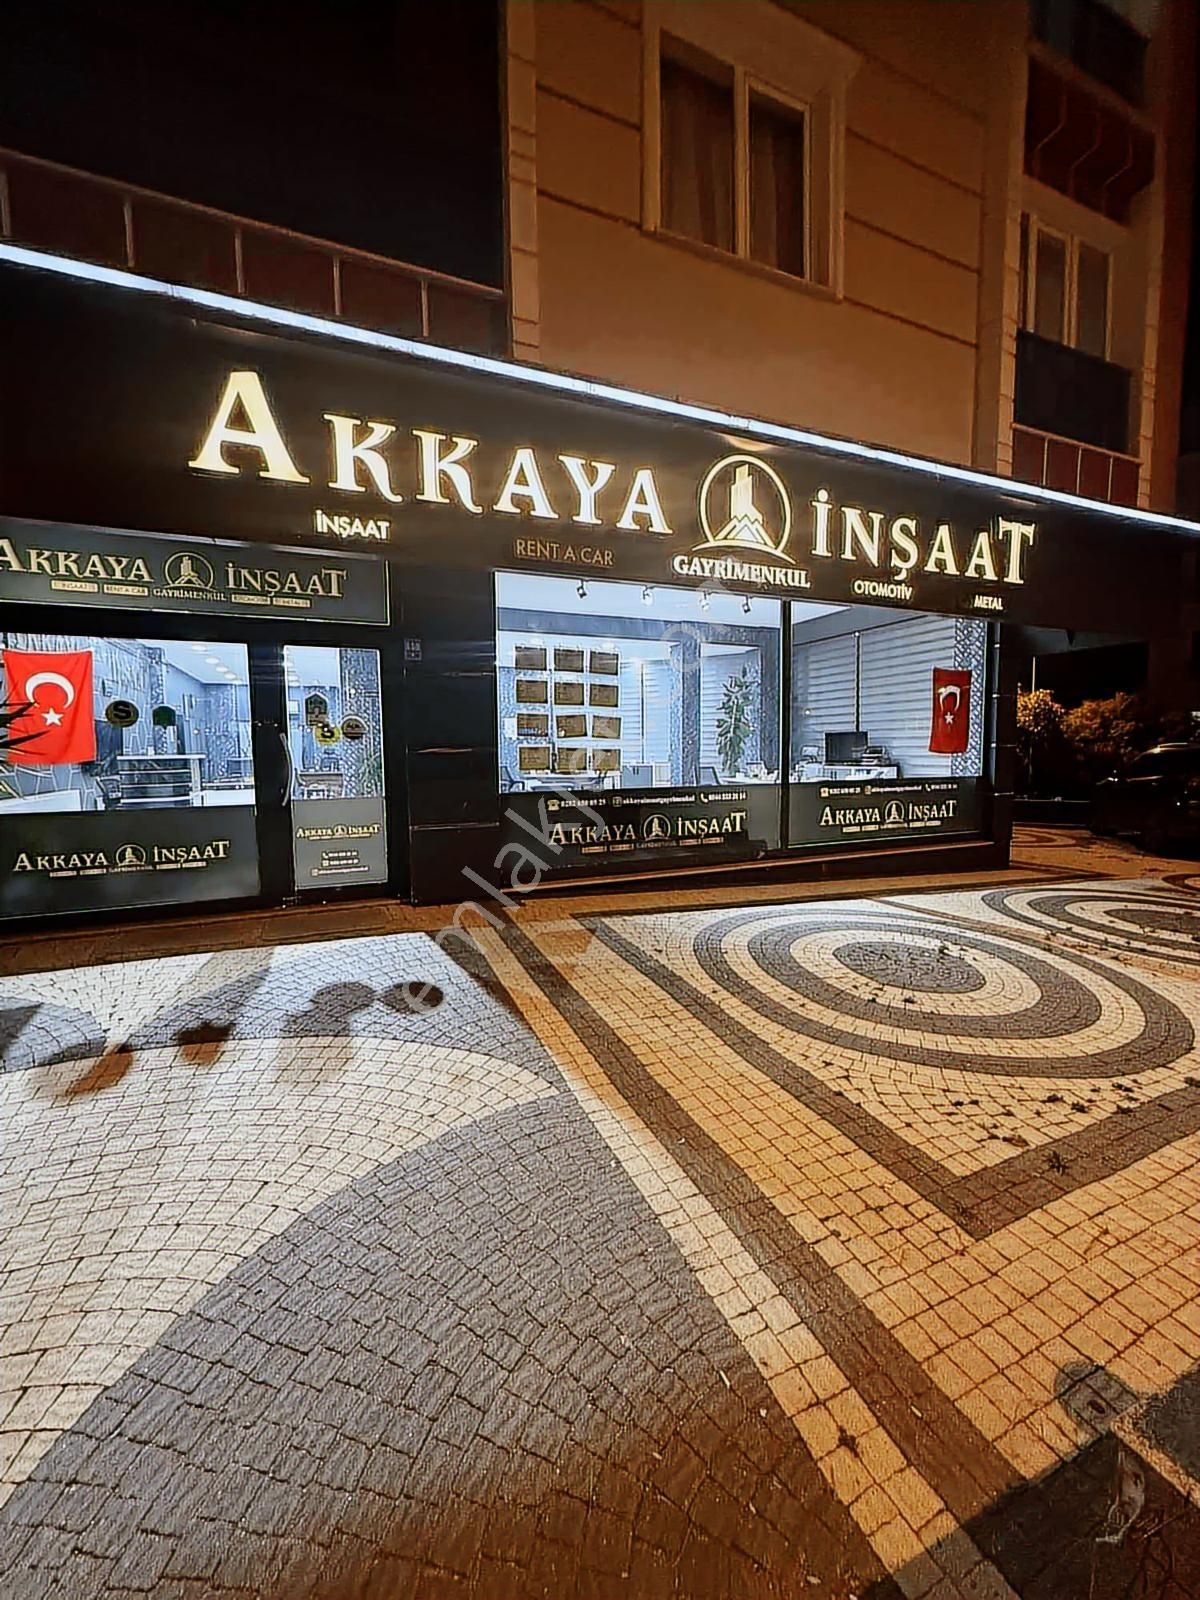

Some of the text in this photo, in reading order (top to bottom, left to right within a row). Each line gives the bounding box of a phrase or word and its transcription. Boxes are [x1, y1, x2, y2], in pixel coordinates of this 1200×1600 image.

[188, 369, 1036, 585] AKKAYA İNŞAAT
[314, 509, 391, 541] İNŞAAT
[0, 538, 347, 597] AKKAYA İNŞAAT
[515, 539, 614, 567] RENT A CAR
[672, 554, 812, 589] GAYRİMENKUL
[853, 578, 914, 602] OTOMOTİV
[973, 593, 1004, 611] METAL
[550, 811, 747, 846] AKKAYA İNŞAAT
[820, 805, 881, 827] AKKAYA
[908, 799, 957, 822] İNŞAAT
[12, 852, 110, 873] AKKAYA
[153, 840, 230, 864] İNŞAAT
